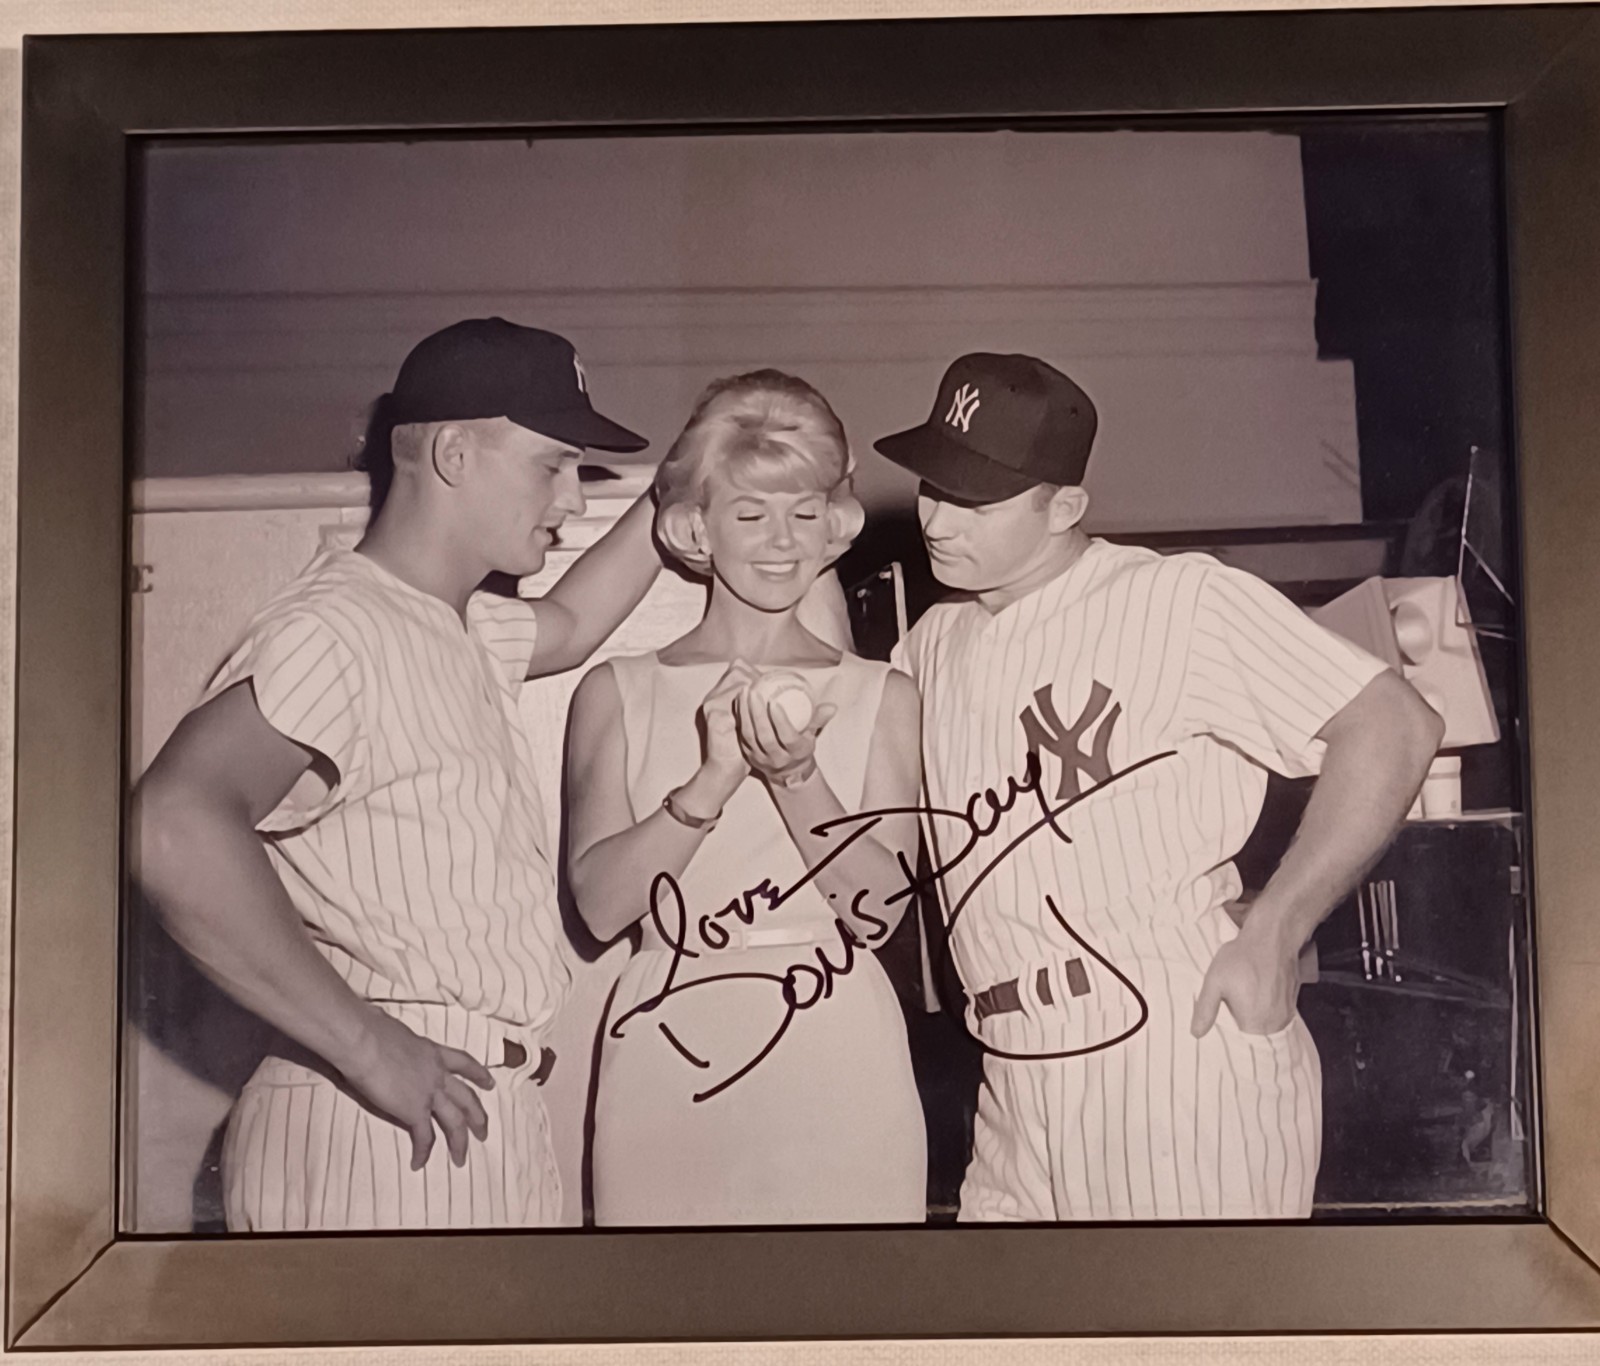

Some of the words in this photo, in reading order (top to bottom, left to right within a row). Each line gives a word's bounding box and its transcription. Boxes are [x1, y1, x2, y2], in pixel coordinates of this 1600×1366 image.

[944, 382, 980, 433] NY
[1019, 679, 1121, 801] NY
[610, 888, 889, 1103] Doris
